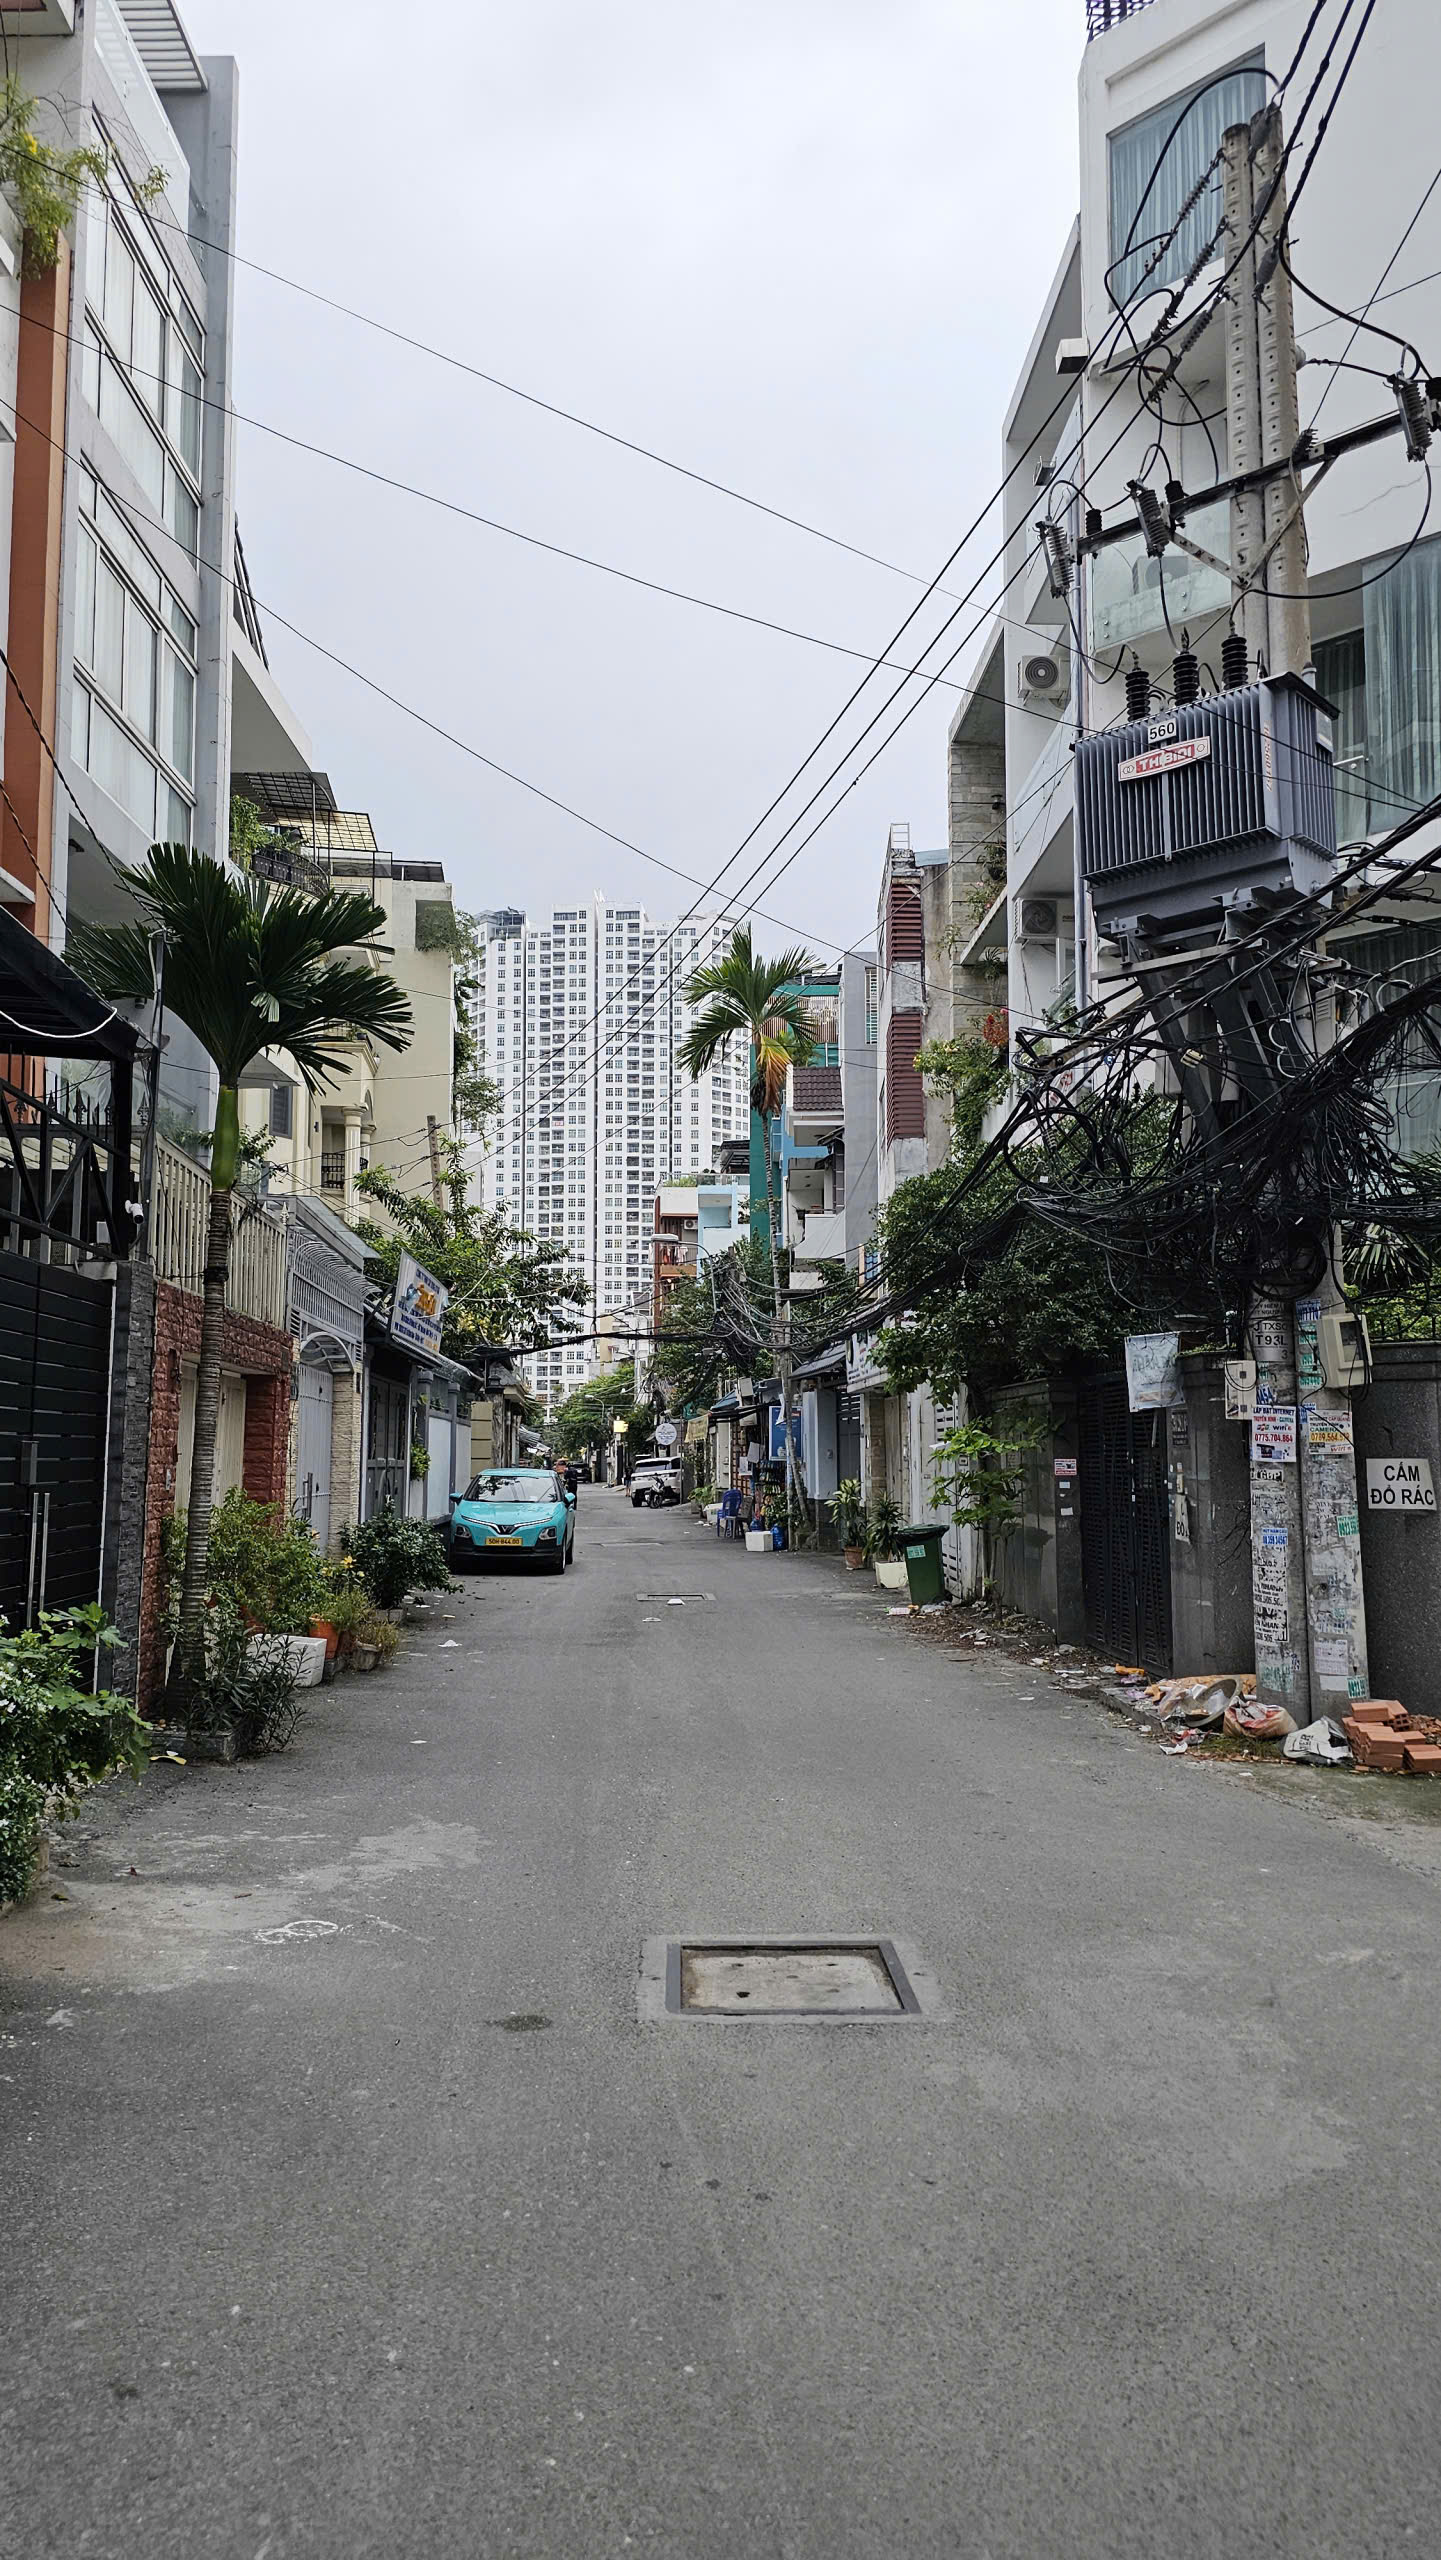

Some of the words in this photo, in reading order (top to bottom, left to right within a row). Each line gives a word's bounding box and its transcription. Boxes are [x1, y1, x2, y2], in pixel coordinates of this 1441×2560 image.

[1149, 722, 1175, 740] 560
[1384, 1461, 1420, 1482] CẤM
[1370, 1484, 1396, 1505] ĐỔ
[1401, 1484, 1434, 1506] RÁC
